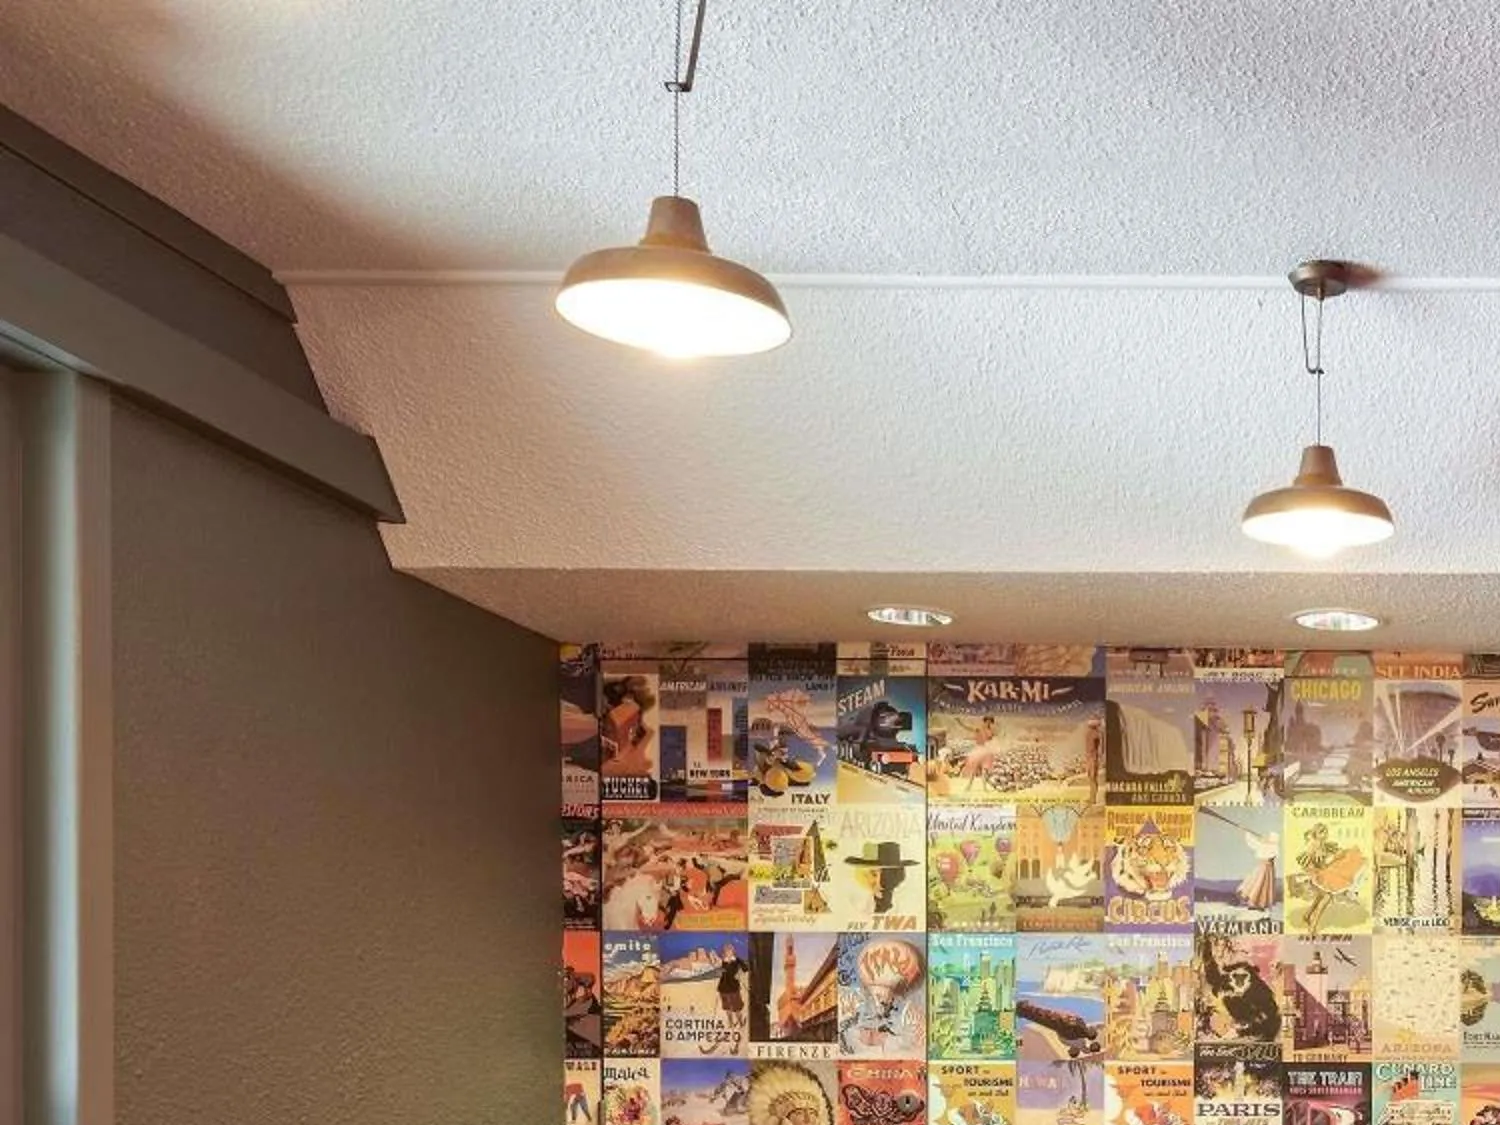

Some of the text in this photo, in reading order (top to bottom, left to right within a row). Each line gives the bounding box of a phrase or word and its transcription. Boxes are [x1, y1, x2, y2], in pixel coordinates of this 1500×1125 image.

[1413, 665, 1462, 679] INDIA
[838, 679, 886, 716] STEAM
[967, 680, 1050, 703] KAR-MI
[1290, 680, 1362, 702] CHICAGO
[790, 793, 832, 805] ITALY
[1292, 807, 1365, 819] CARIBBEAN
[1107, 895, 1191, 923] CIRCUS
[871, 915, 918, 931] TWA
[665, 1019, 725, 1029] CORTINA
[757, 1046, 832, 1058] FIRENZE
[941, 1065, 980, 1075] SPORT
[1117, 1065, 1156, 1075] SPORT
[1196, 1103, 1281, 1117] PARIS
